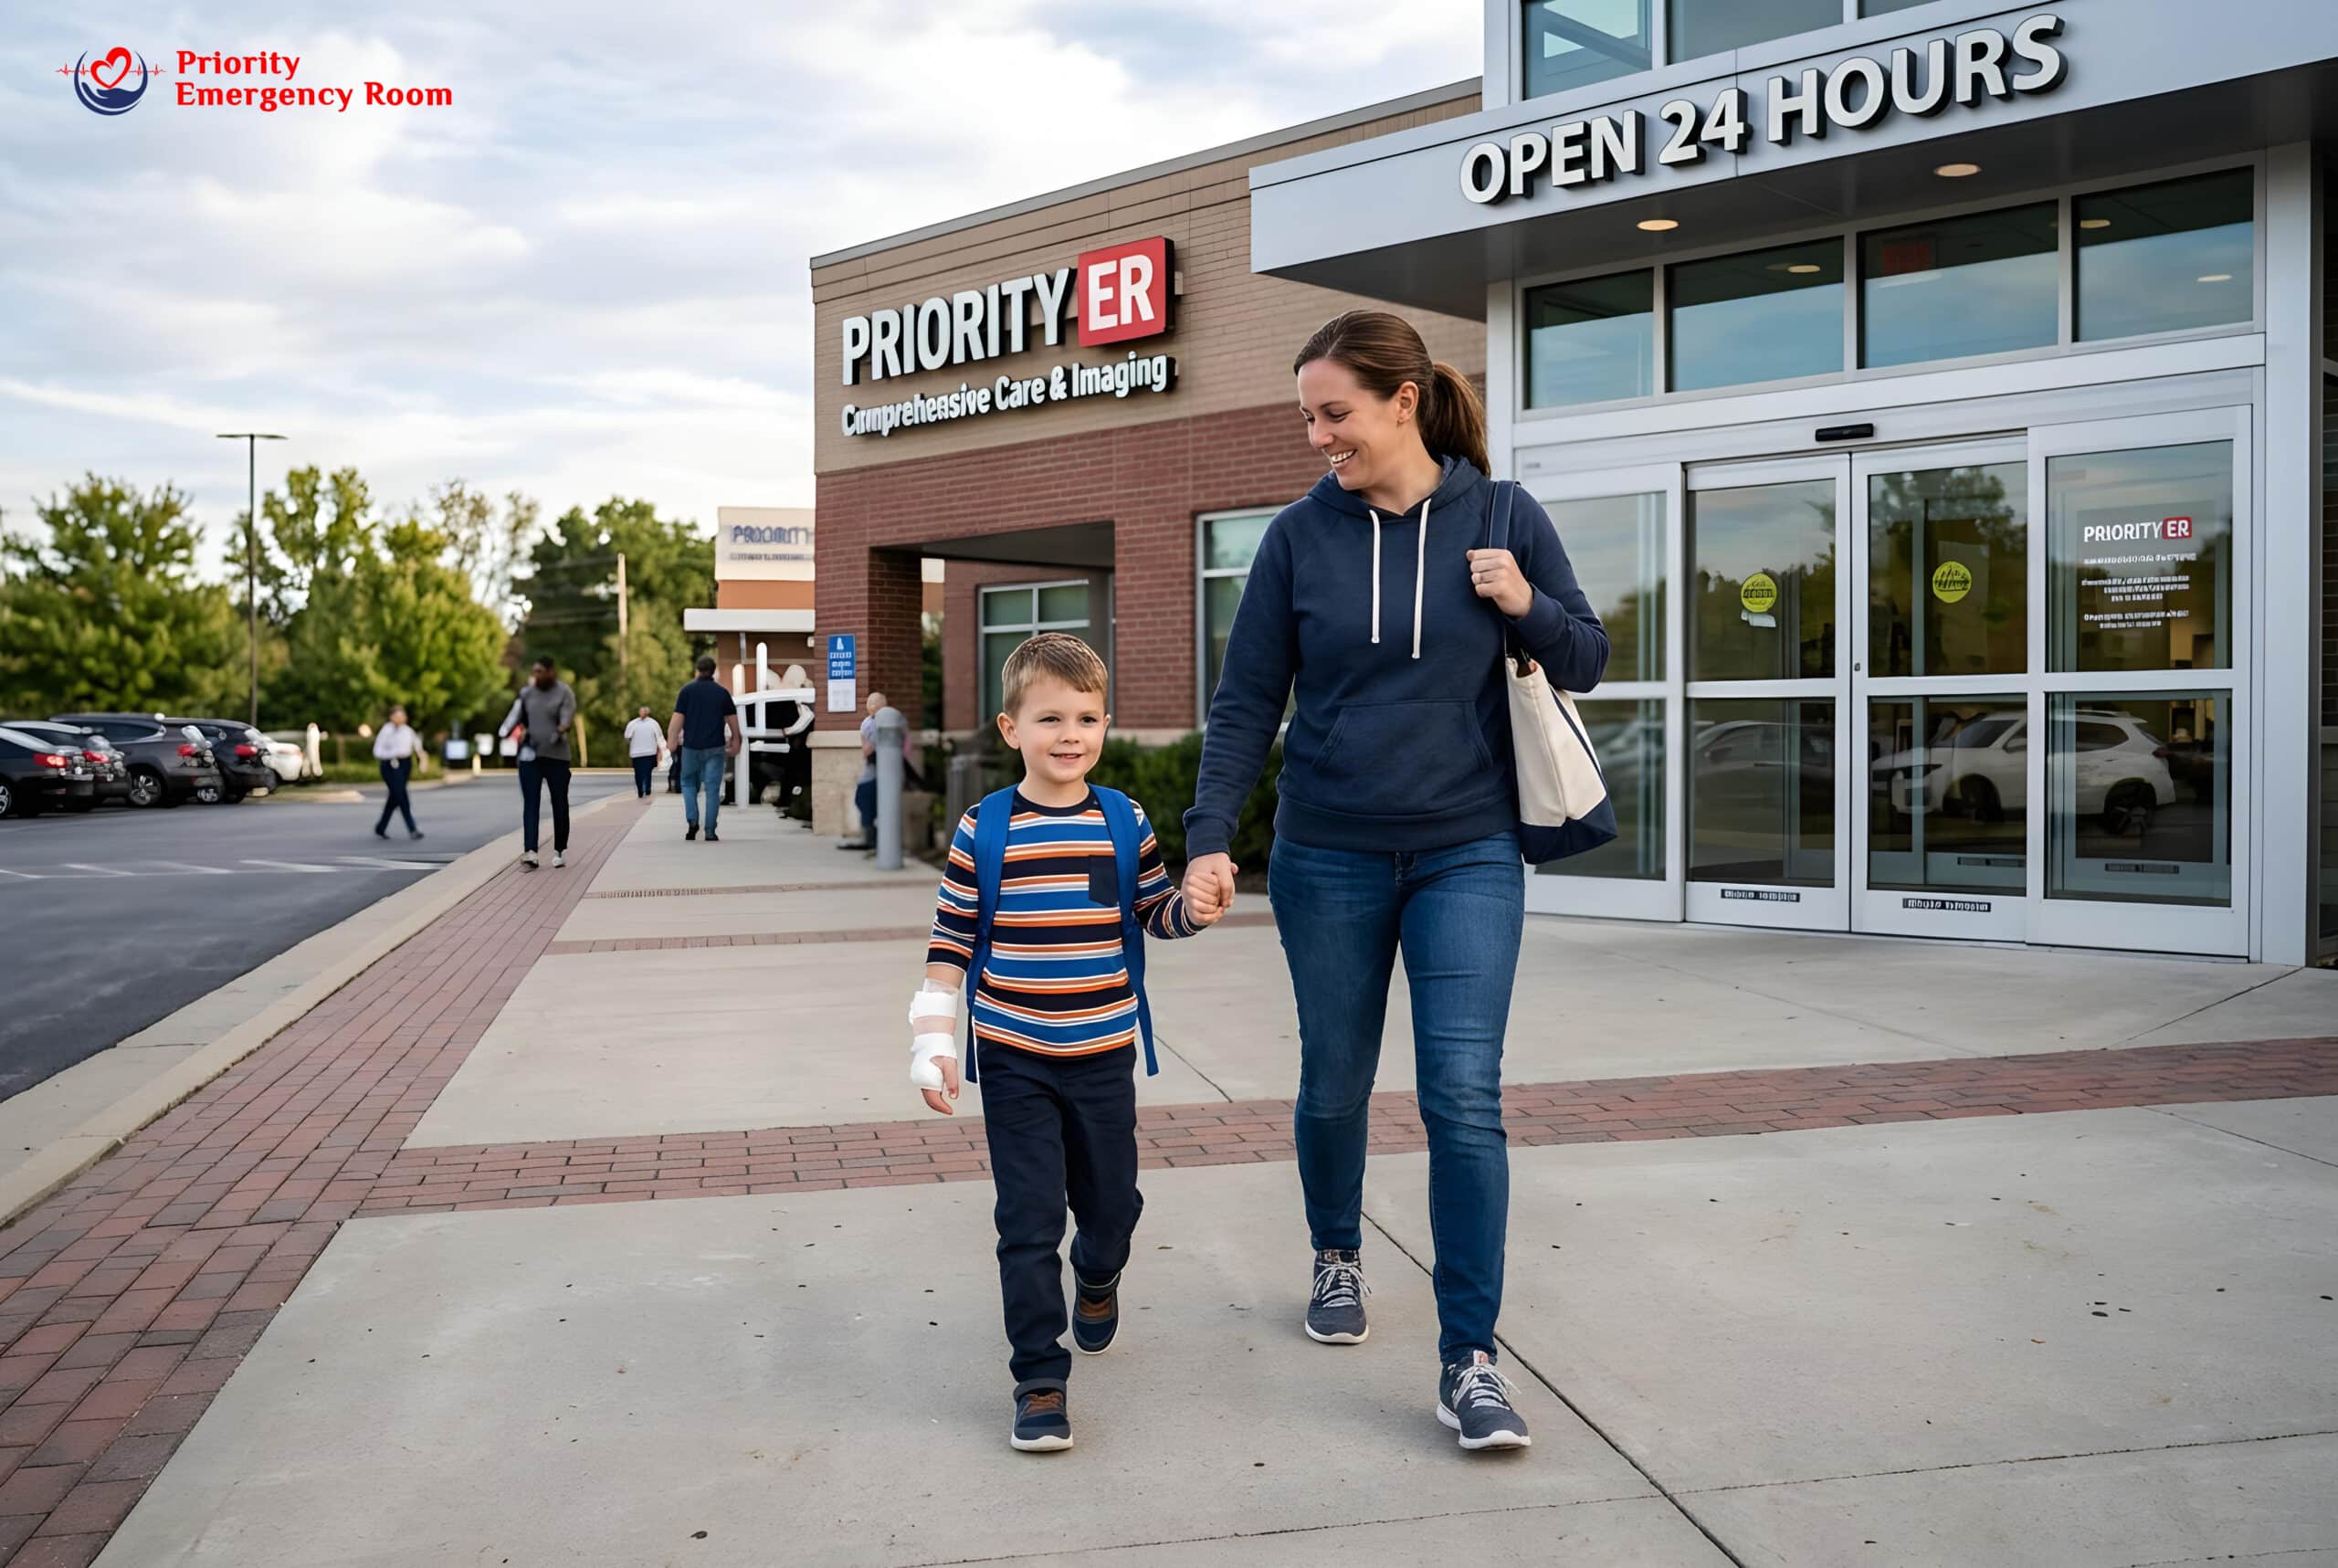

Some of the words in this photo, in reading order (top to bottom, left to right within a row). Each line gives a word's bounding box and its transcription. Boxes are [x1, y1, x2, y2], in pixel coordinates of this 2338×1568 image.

[1460, 109, 1644, 205] OPEN
[1658, 87, 1751, 166] 24
[1766, 13, 2068, 144] HOURS
[842, 267, 1076, 386] PRIORITY
[1088, 254, 1155, 331] ER
[994, 375, 1046, 411] Care
[1048, 365, 1068, 401] &
[1071, 351, 1168, 398] Imaging
[2083, 521, 2163, 542] PRIORITY
[2166, 519, 2189, 537] ER
